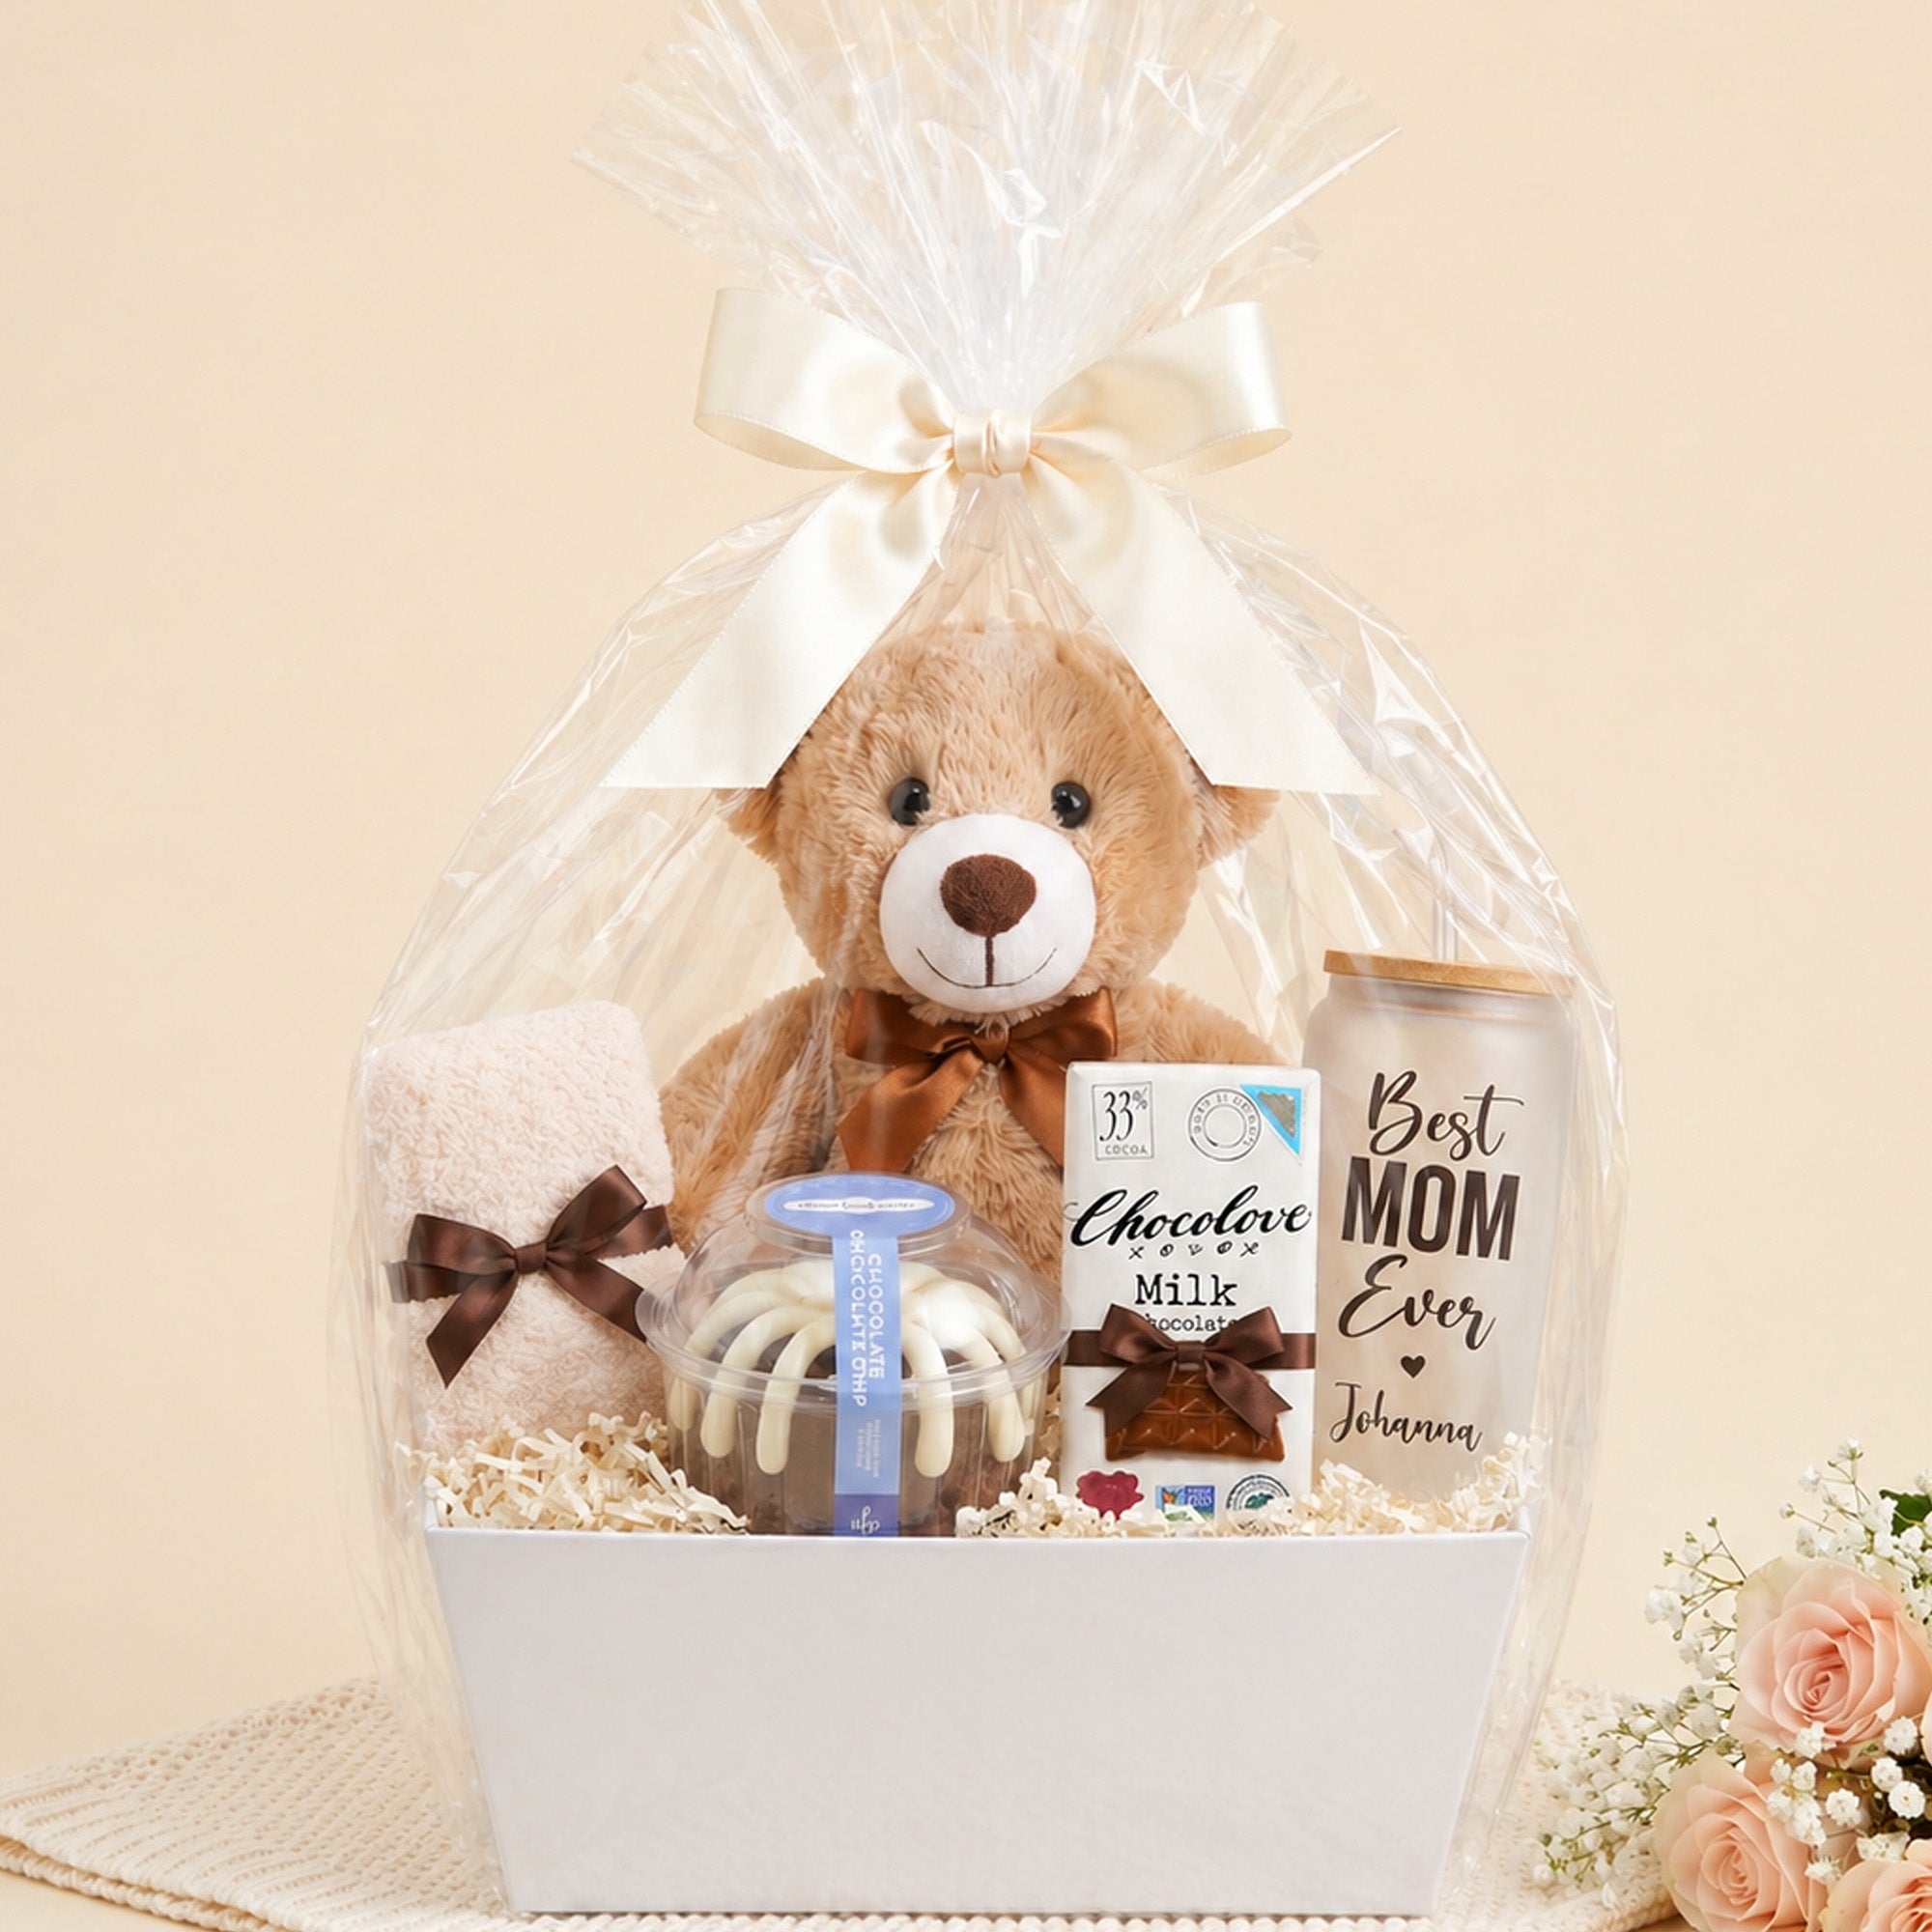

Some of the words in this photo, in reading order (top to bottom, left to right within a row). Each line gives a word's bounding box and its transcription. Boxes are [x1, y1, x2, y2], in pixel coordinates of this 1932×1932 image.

[1099, 1087, 1149, 1142] 33%
[1368, 1070, 1524, 1161] Best
[1105, 1145, 1150, 1155] COCOA
[1069, 1184, 1312, 1247] Chocolove
[1341, 1155, 1520, 1262] MOM
[1134, 1272, 1238, 1307] Milk
[1338, 1254, 1496, 1350] Ever
[1329, 1382, 1483, 1452] Johanna
